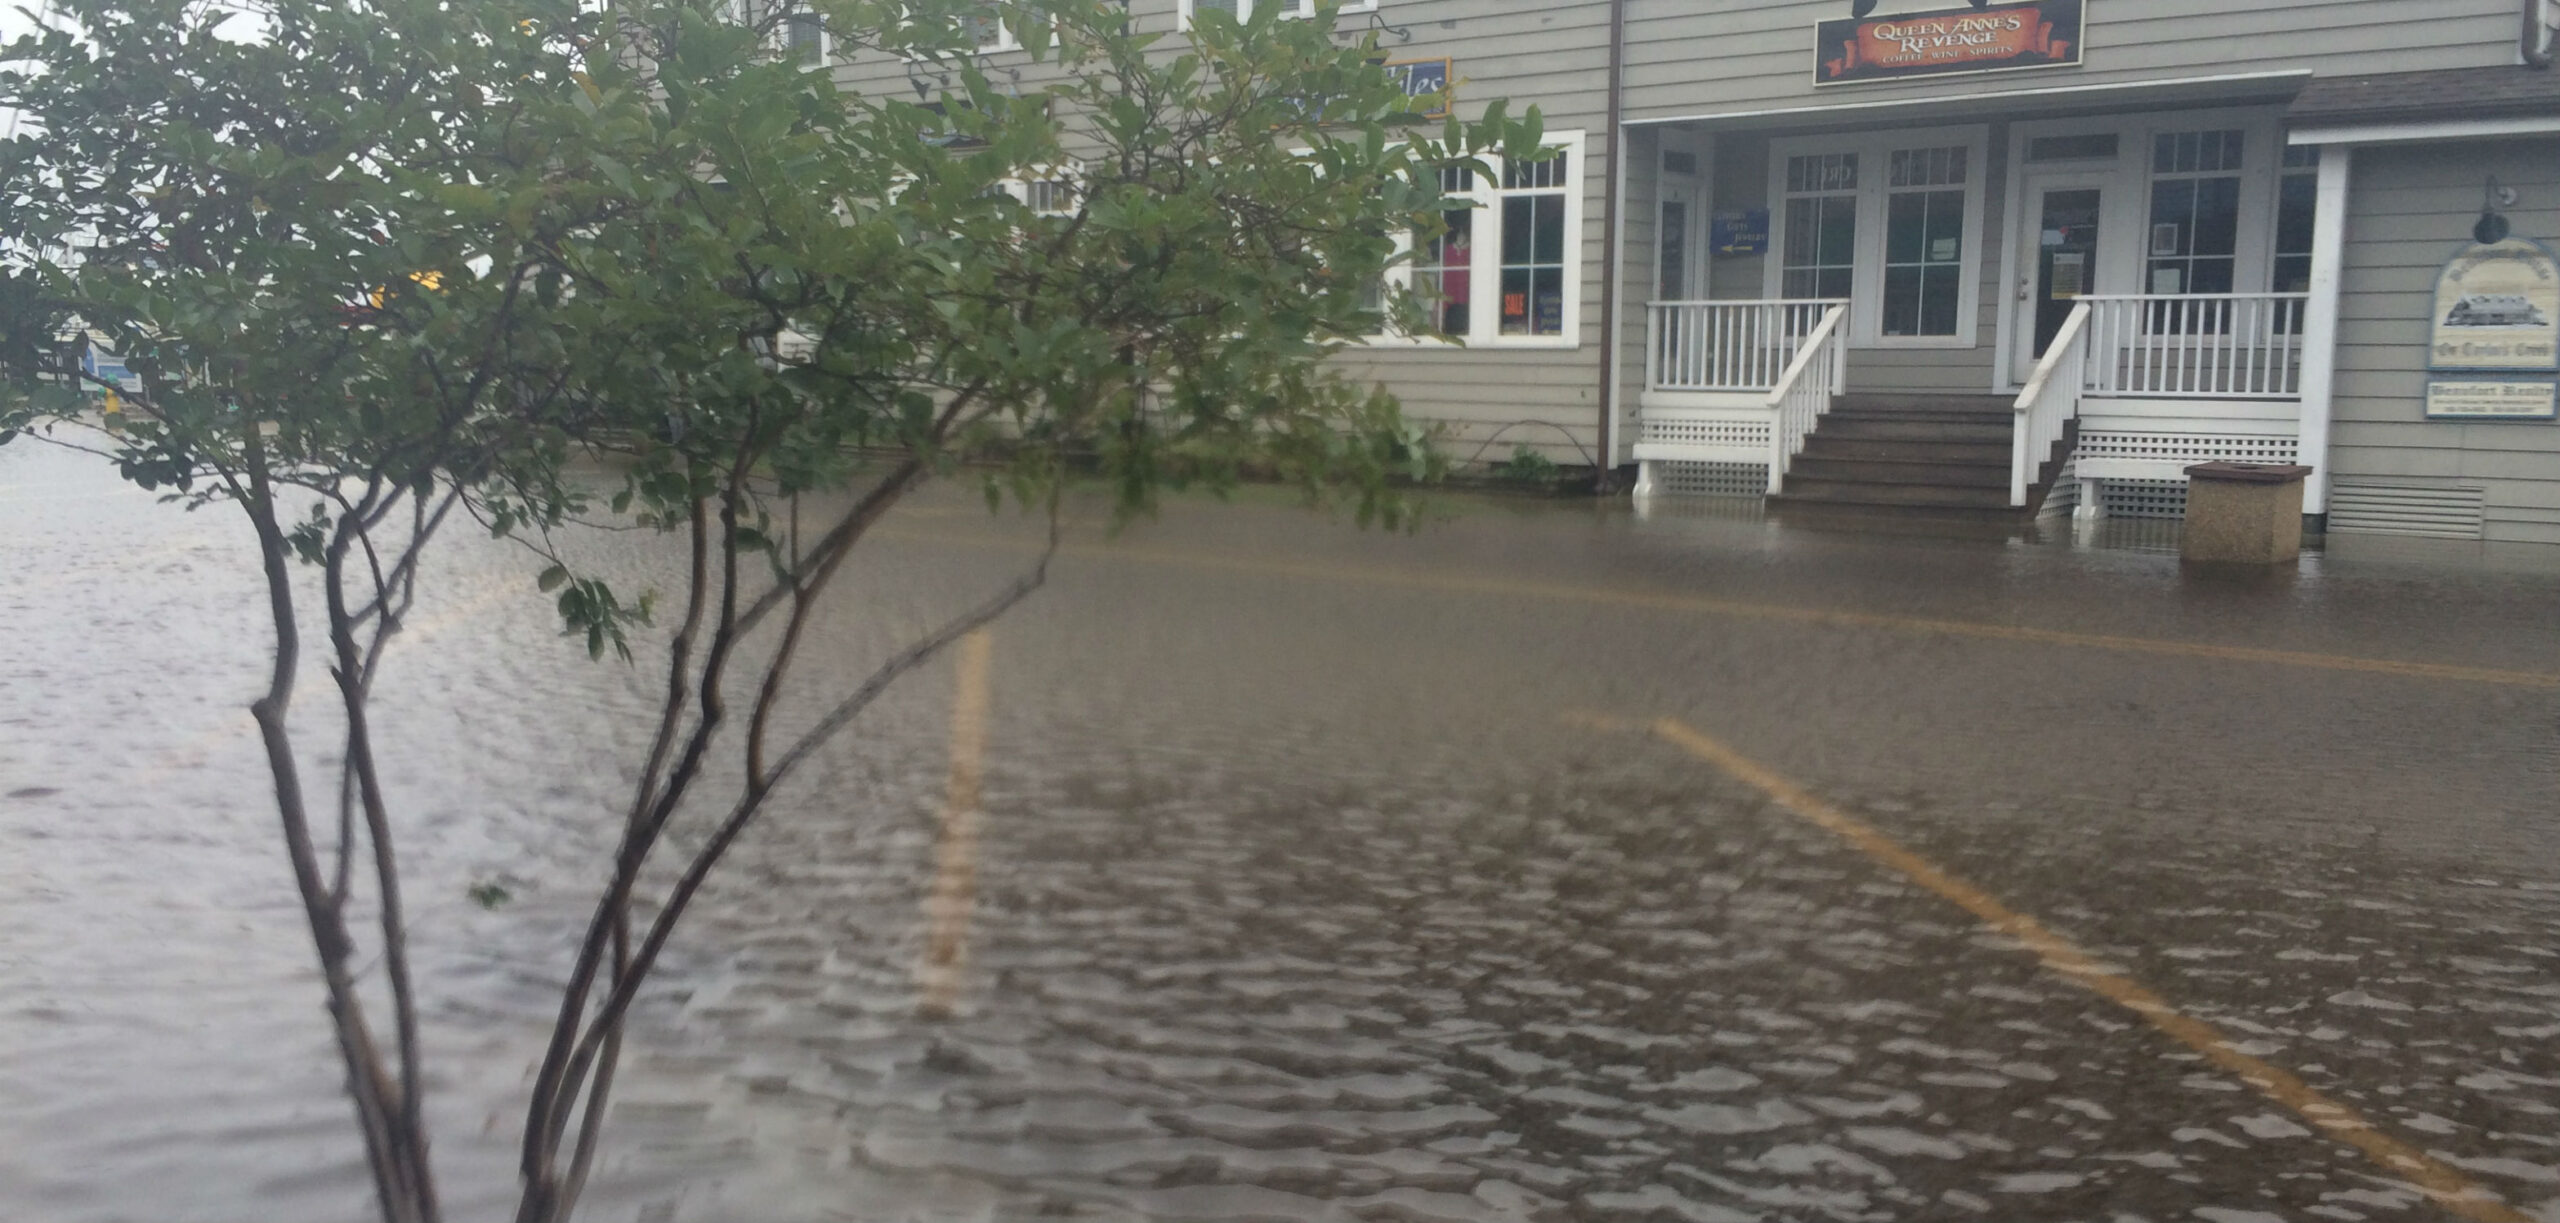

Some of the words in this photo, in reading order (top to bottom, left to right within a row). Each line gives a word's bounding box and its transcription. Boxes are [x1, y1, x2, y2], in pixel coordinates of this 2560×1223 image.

[1873, 22, 1946, 41] QUEEN
[1900, 31, 1998, 53] REVENGE
[1882, 53, 1923, 63] COFFEE
[1930, 50, 1960, 60] WINE
[1969, 46, 2013, 57] SPIRITS
